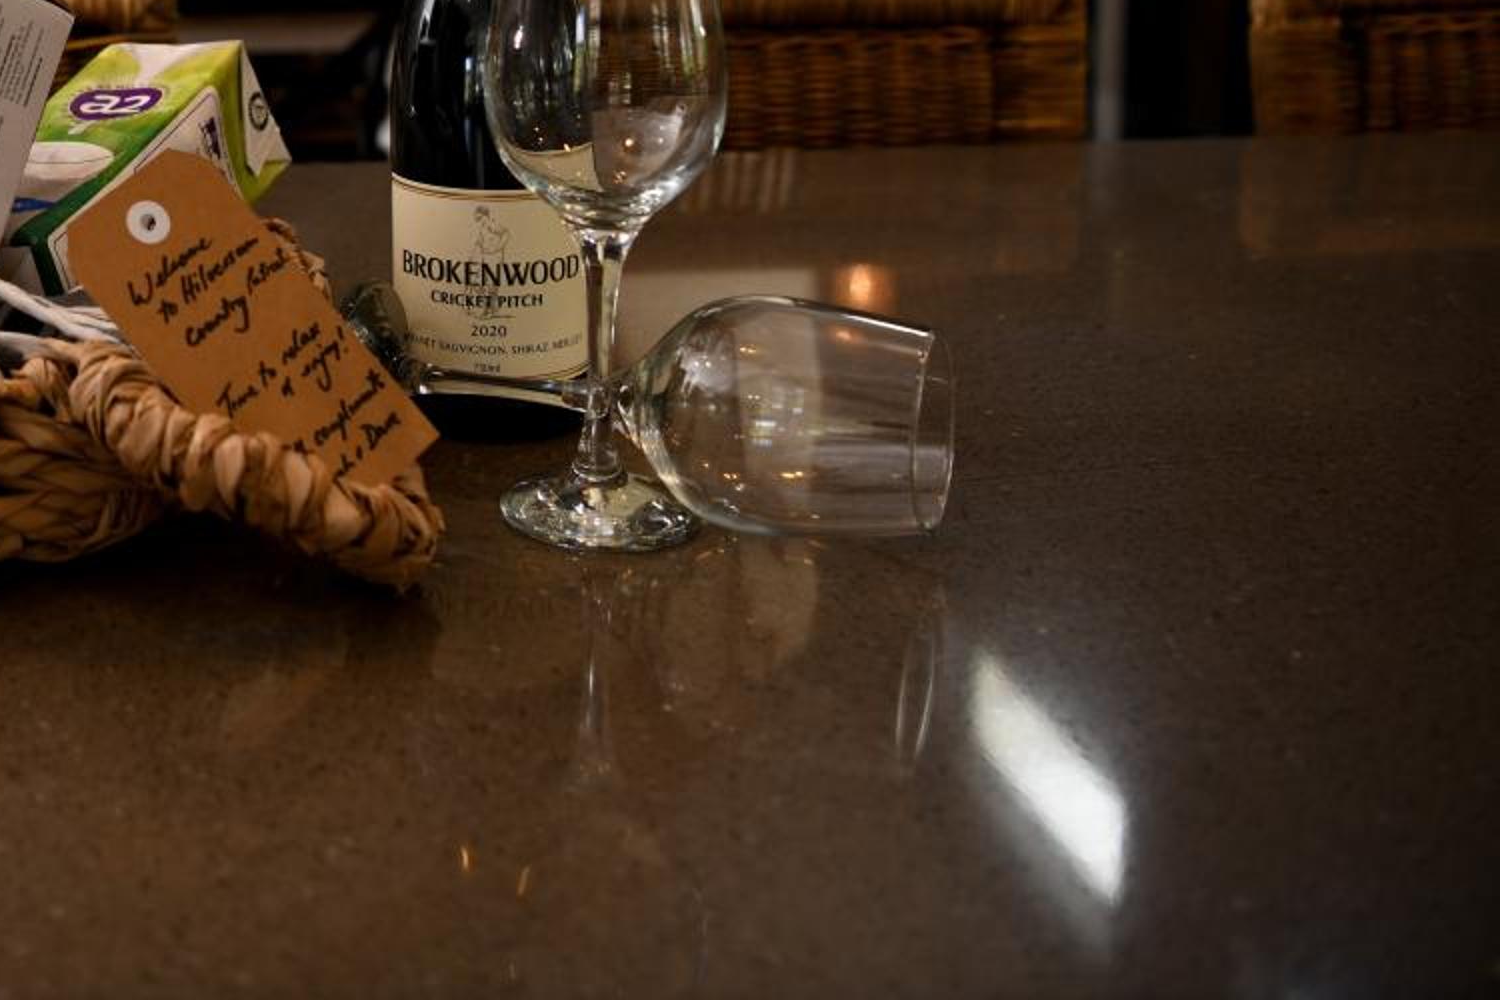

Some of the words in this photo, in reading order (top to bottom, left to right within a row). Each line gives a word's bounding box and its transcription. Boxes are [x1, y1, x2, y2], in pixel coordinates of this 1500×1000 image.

[79, 94, 152, 115] a2
[127, 237, 212, 306] Welcome
[402, 249, 580, 287] BROKENWOOD
[156, 299, 179, 324] to
[431, 289, 493, 309] CRICKET
[497, 293, 543, 309] PITCH
[471, 325, 507, 338] 2020
[281, 322, 321, 367] relax
